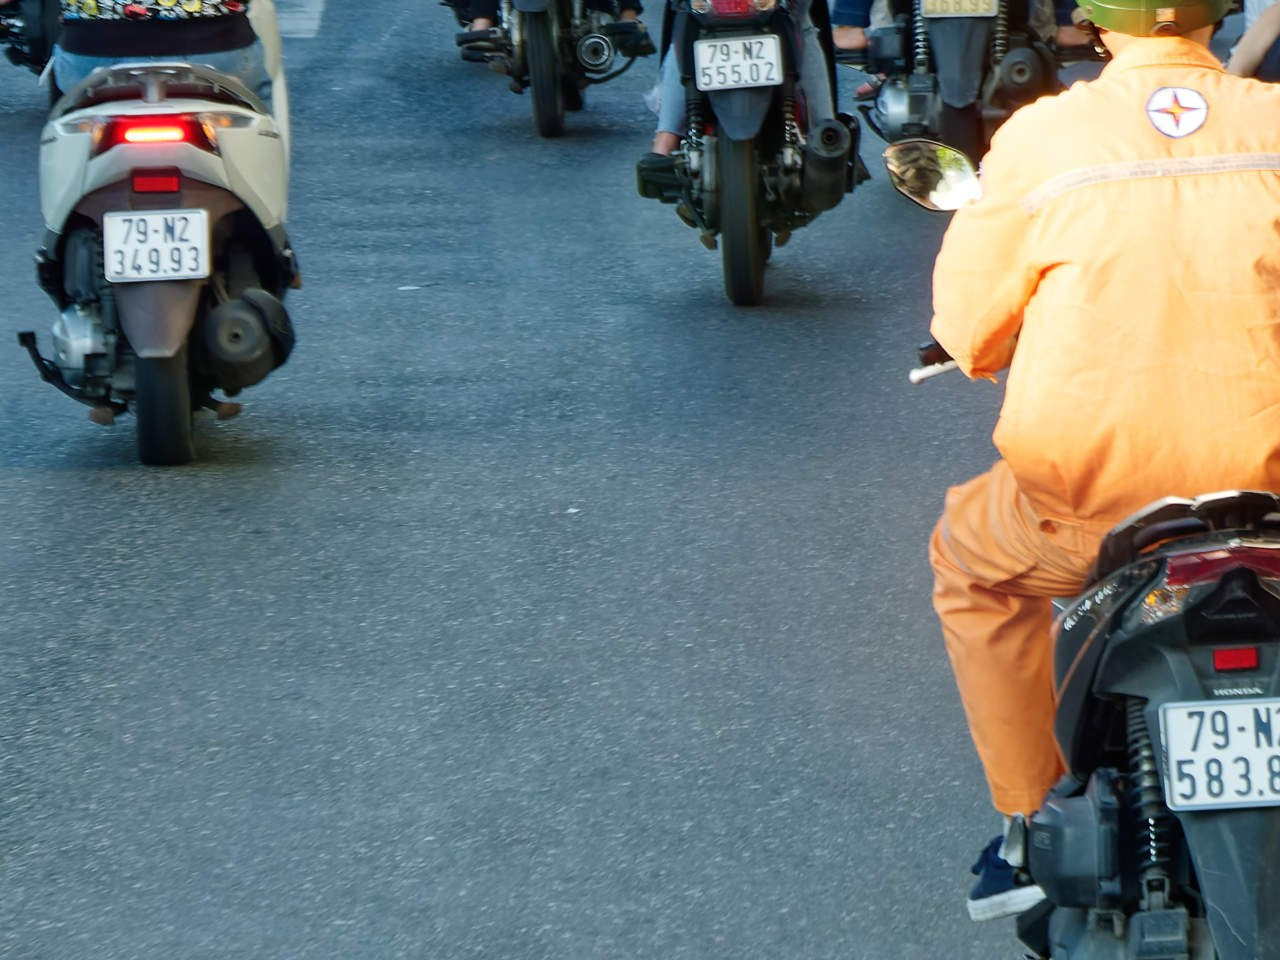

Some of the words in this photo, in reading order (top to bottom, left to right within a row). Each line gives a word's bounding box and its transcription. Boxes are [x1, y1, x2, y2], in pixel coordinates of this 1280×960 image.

[707, 41, 765, 63] 79-N2
[701, 62, 776, 87] 555.02
[121, 216, 190, 245] 79-N2
[113, 245, 200, 276] 349.93
[1213, 687, 1265, 696] HONDA
